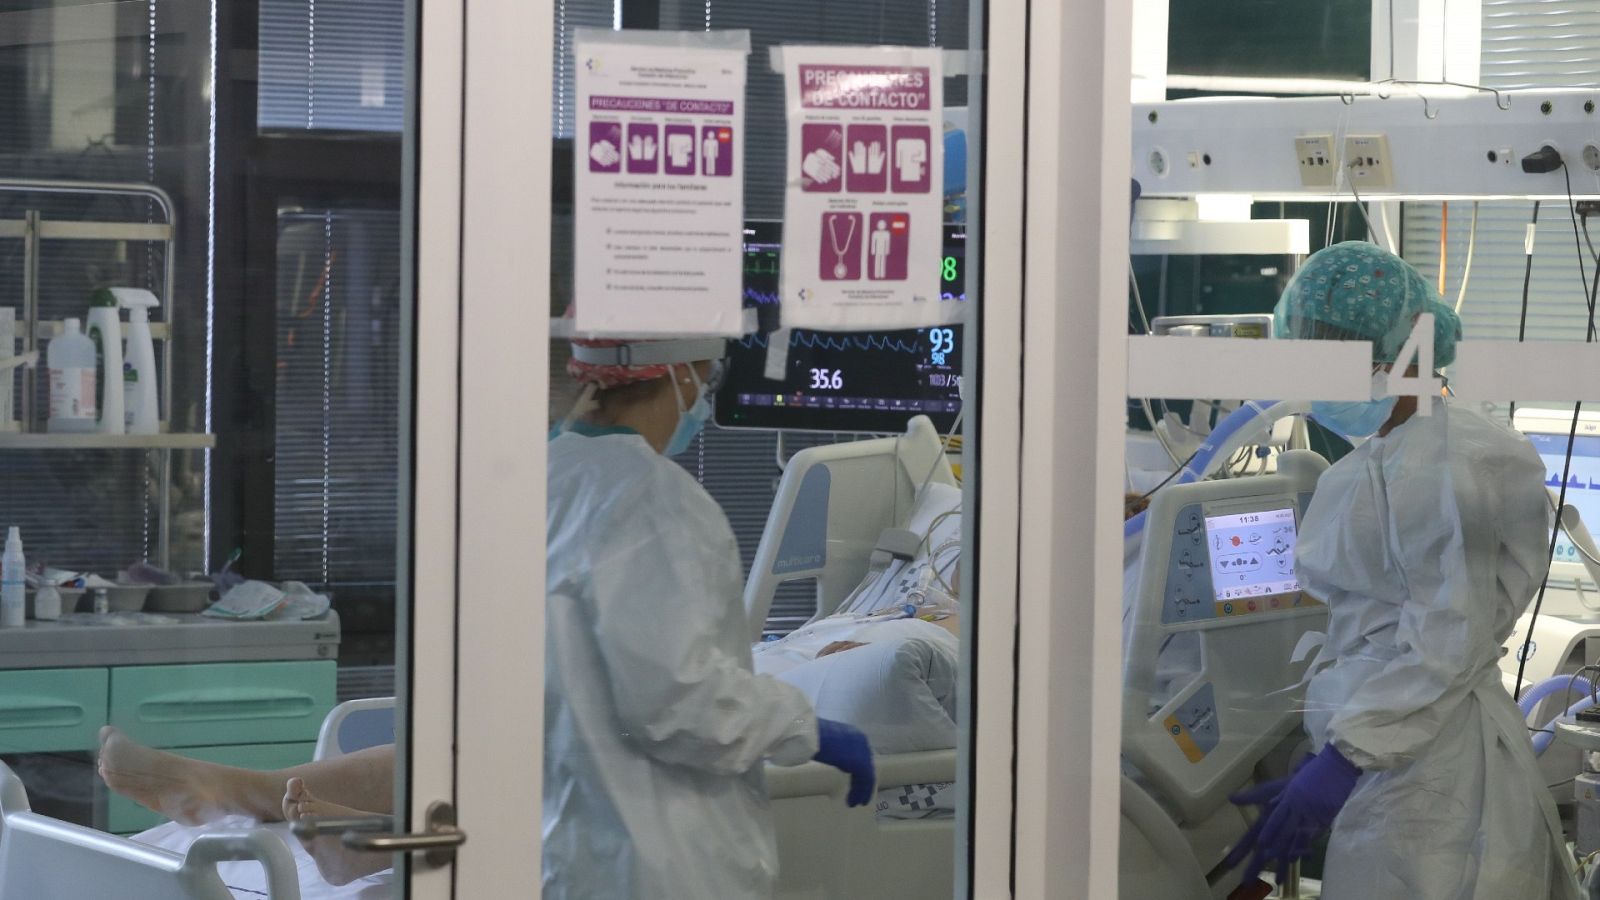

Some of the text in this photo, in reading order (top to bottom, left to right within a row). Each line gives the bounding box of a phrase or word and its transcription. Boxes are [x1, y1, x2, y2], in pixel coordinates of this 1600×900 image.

[804, 70, 924, 88] PRENES
[838, 92, 926, 107] CONTACTO"
[930, 328, 953, 353] 93
[931, 351, 945, 365] 98
[1386, 312, 1442, 416] 4
[809, 368, 843, 389] 35.6
